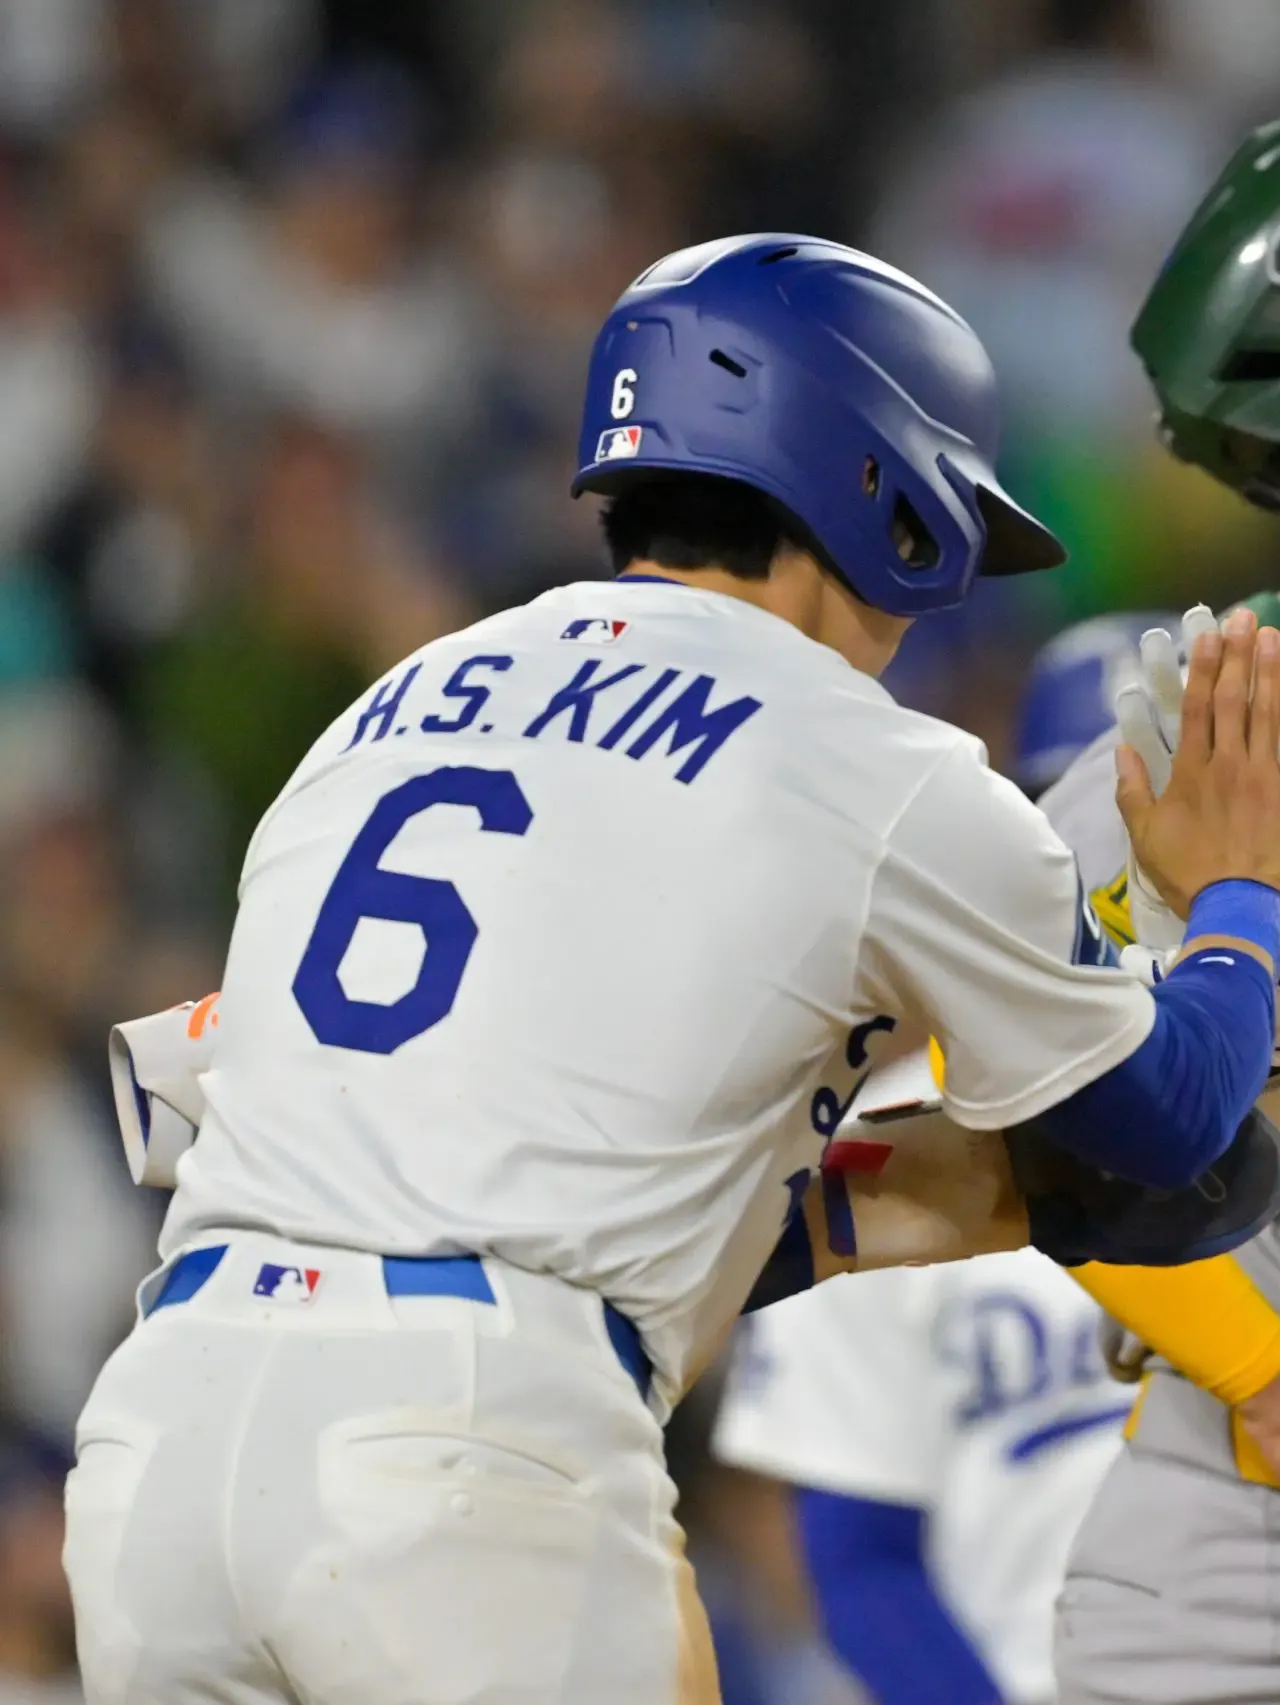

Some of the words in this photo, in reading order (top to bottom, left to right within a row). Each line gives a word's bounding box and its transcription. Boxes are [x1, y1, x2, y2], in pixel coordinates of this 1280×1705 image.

[610, 368, 638, 419] 6
[338, 655, 515, 755] H.S.
[522, 659, 764, 786] KIM
[291, 764, 535, 1056] 6
